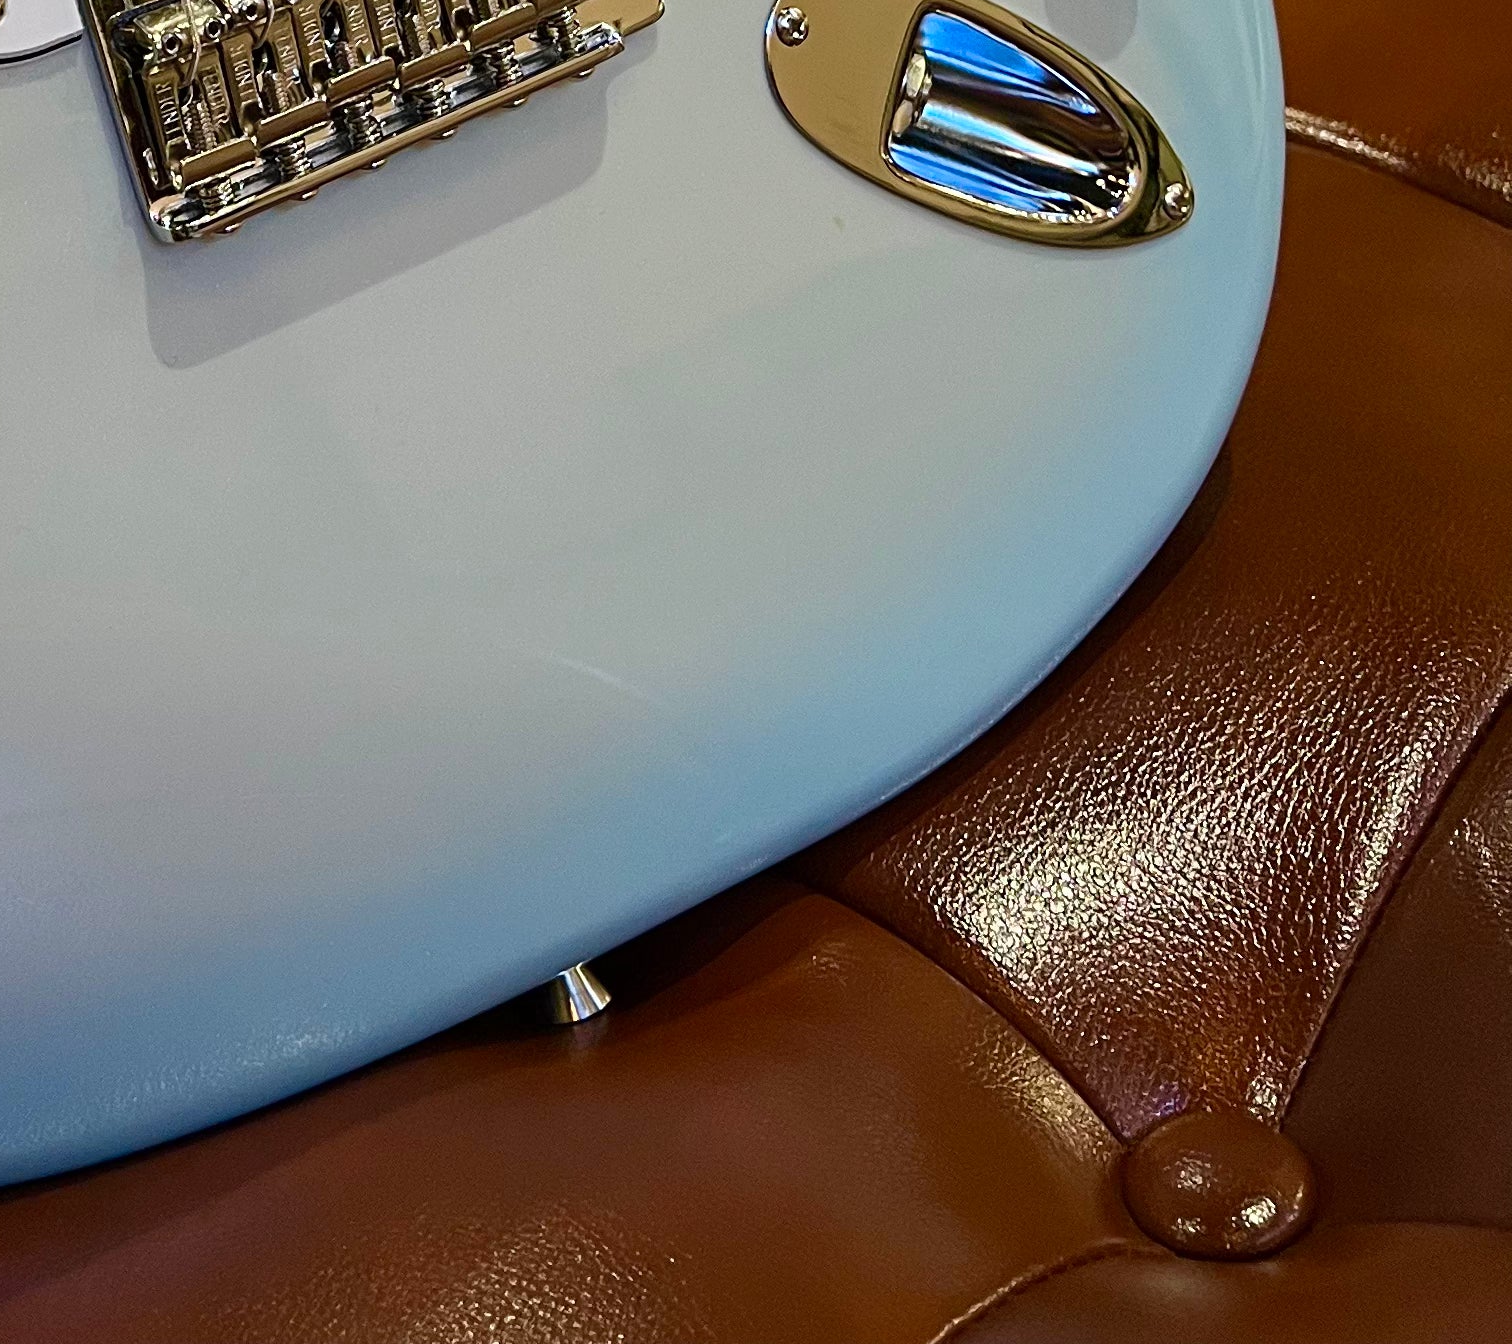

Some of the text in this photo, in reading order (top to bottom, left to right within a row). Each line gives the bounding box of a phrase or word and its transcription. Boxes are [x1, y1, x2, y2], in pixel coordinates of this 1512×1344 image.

[299, 3, 325, 60] ENDER
[230, 43, 257, 103] ENDER
[155, 83, 183, 140] ENDER
